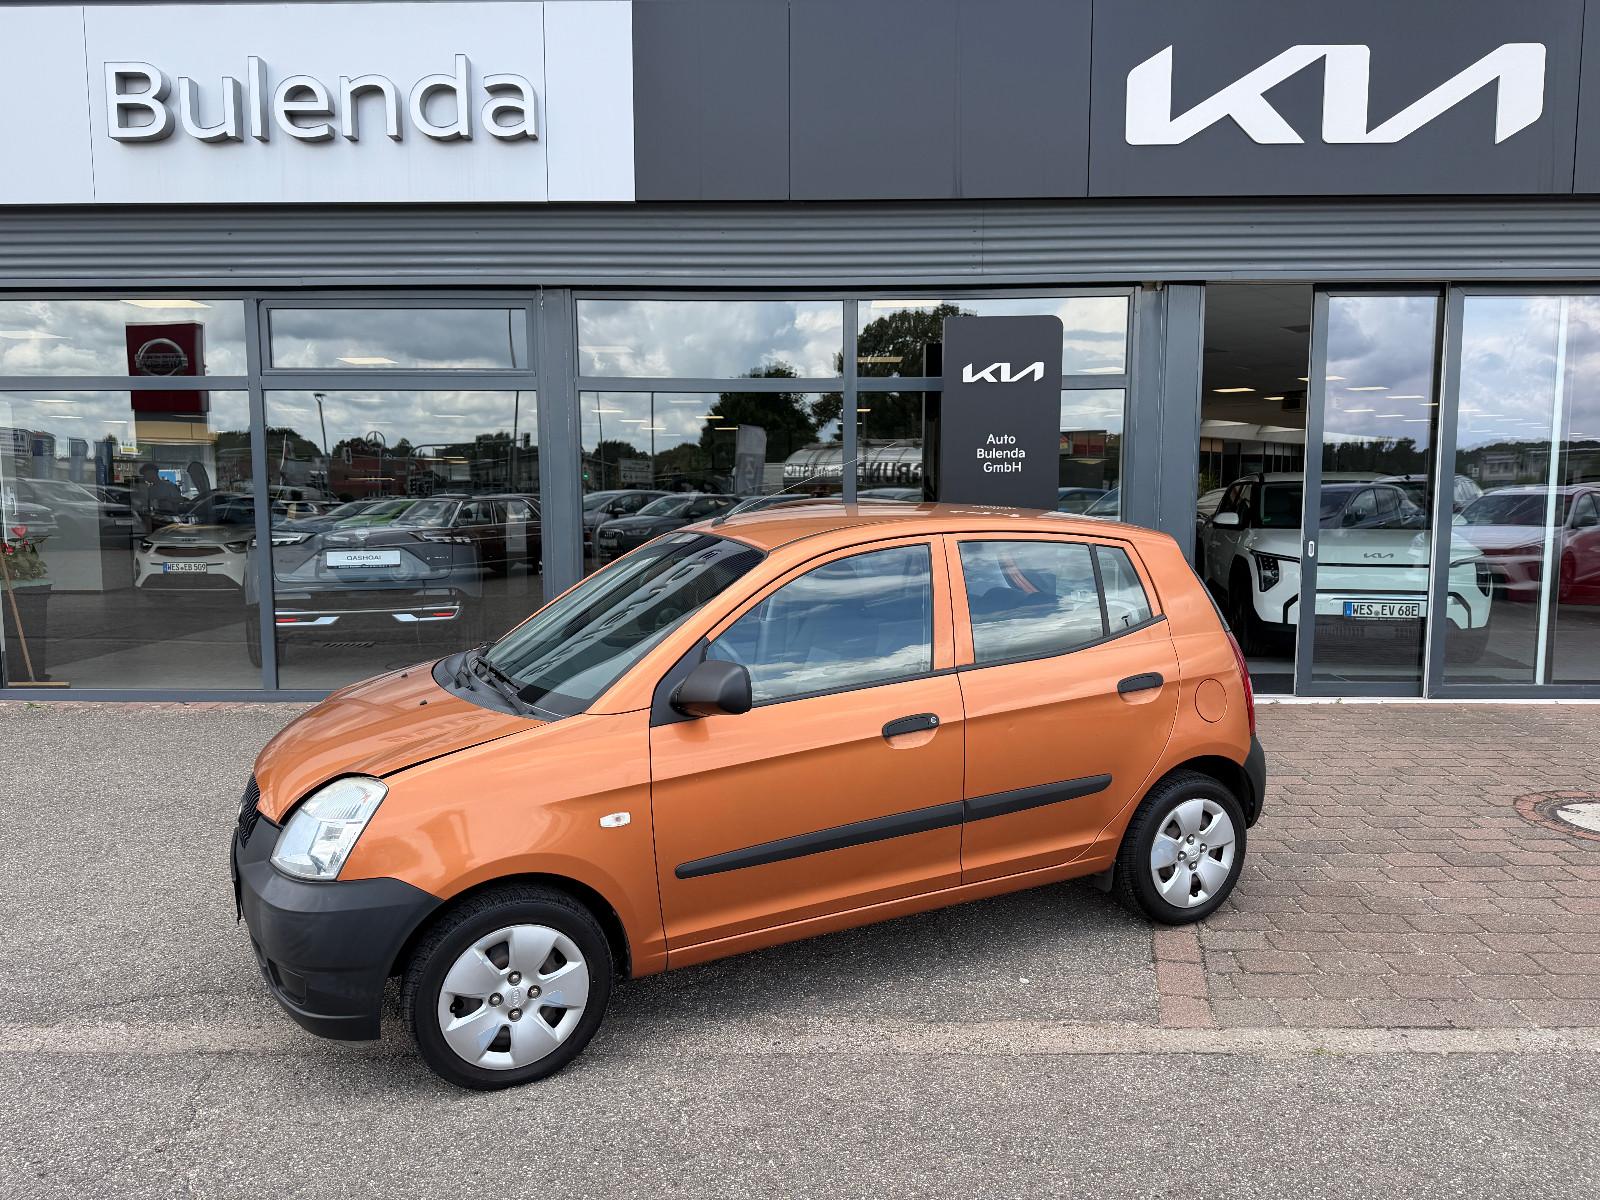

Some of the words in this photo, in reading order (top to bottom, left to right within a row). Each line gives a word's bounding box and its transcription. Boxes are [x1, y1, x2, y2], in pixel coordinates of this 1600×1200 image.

[103, 53, 538, 144] Bulenda
[1125, 42, 1546, 146] KIA
[962, 361, 1045, 383] KIA
[986, 433, 1017, 445] Auto
[976, 447, 1026, 459] Bulenda
[983, 461, 1022, 473] GmbH
[167, 563, 180, 571] WES
[1352, 604, 1374, 616] WES
[1381, 604, 1396, 616] EV
[1397, 605, 1418, 617] 68E
